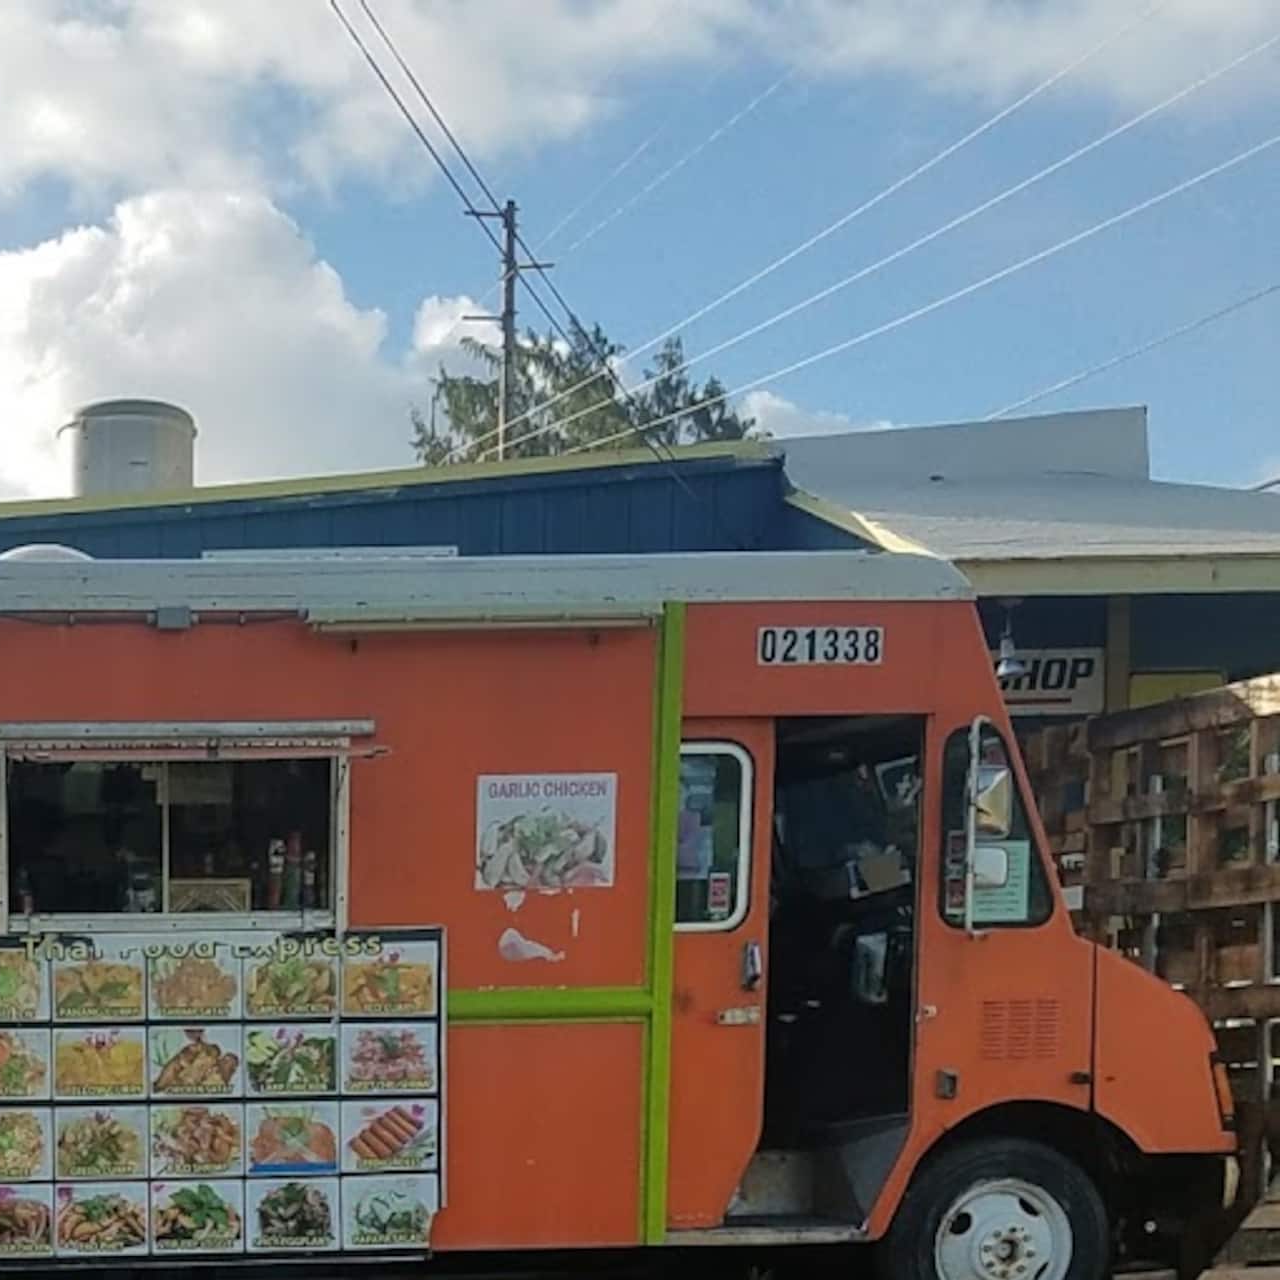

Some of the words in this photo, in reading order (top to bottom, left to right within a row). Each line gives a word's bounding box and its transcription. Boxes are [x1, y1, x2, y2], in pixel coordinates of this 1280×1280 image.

[761, 629, 880, 662] 021338
[488, 782, 540, 799] GARLIC
[544, 780, 607, 798] CHICKEN
[20, 936, 104, 961] Thai
